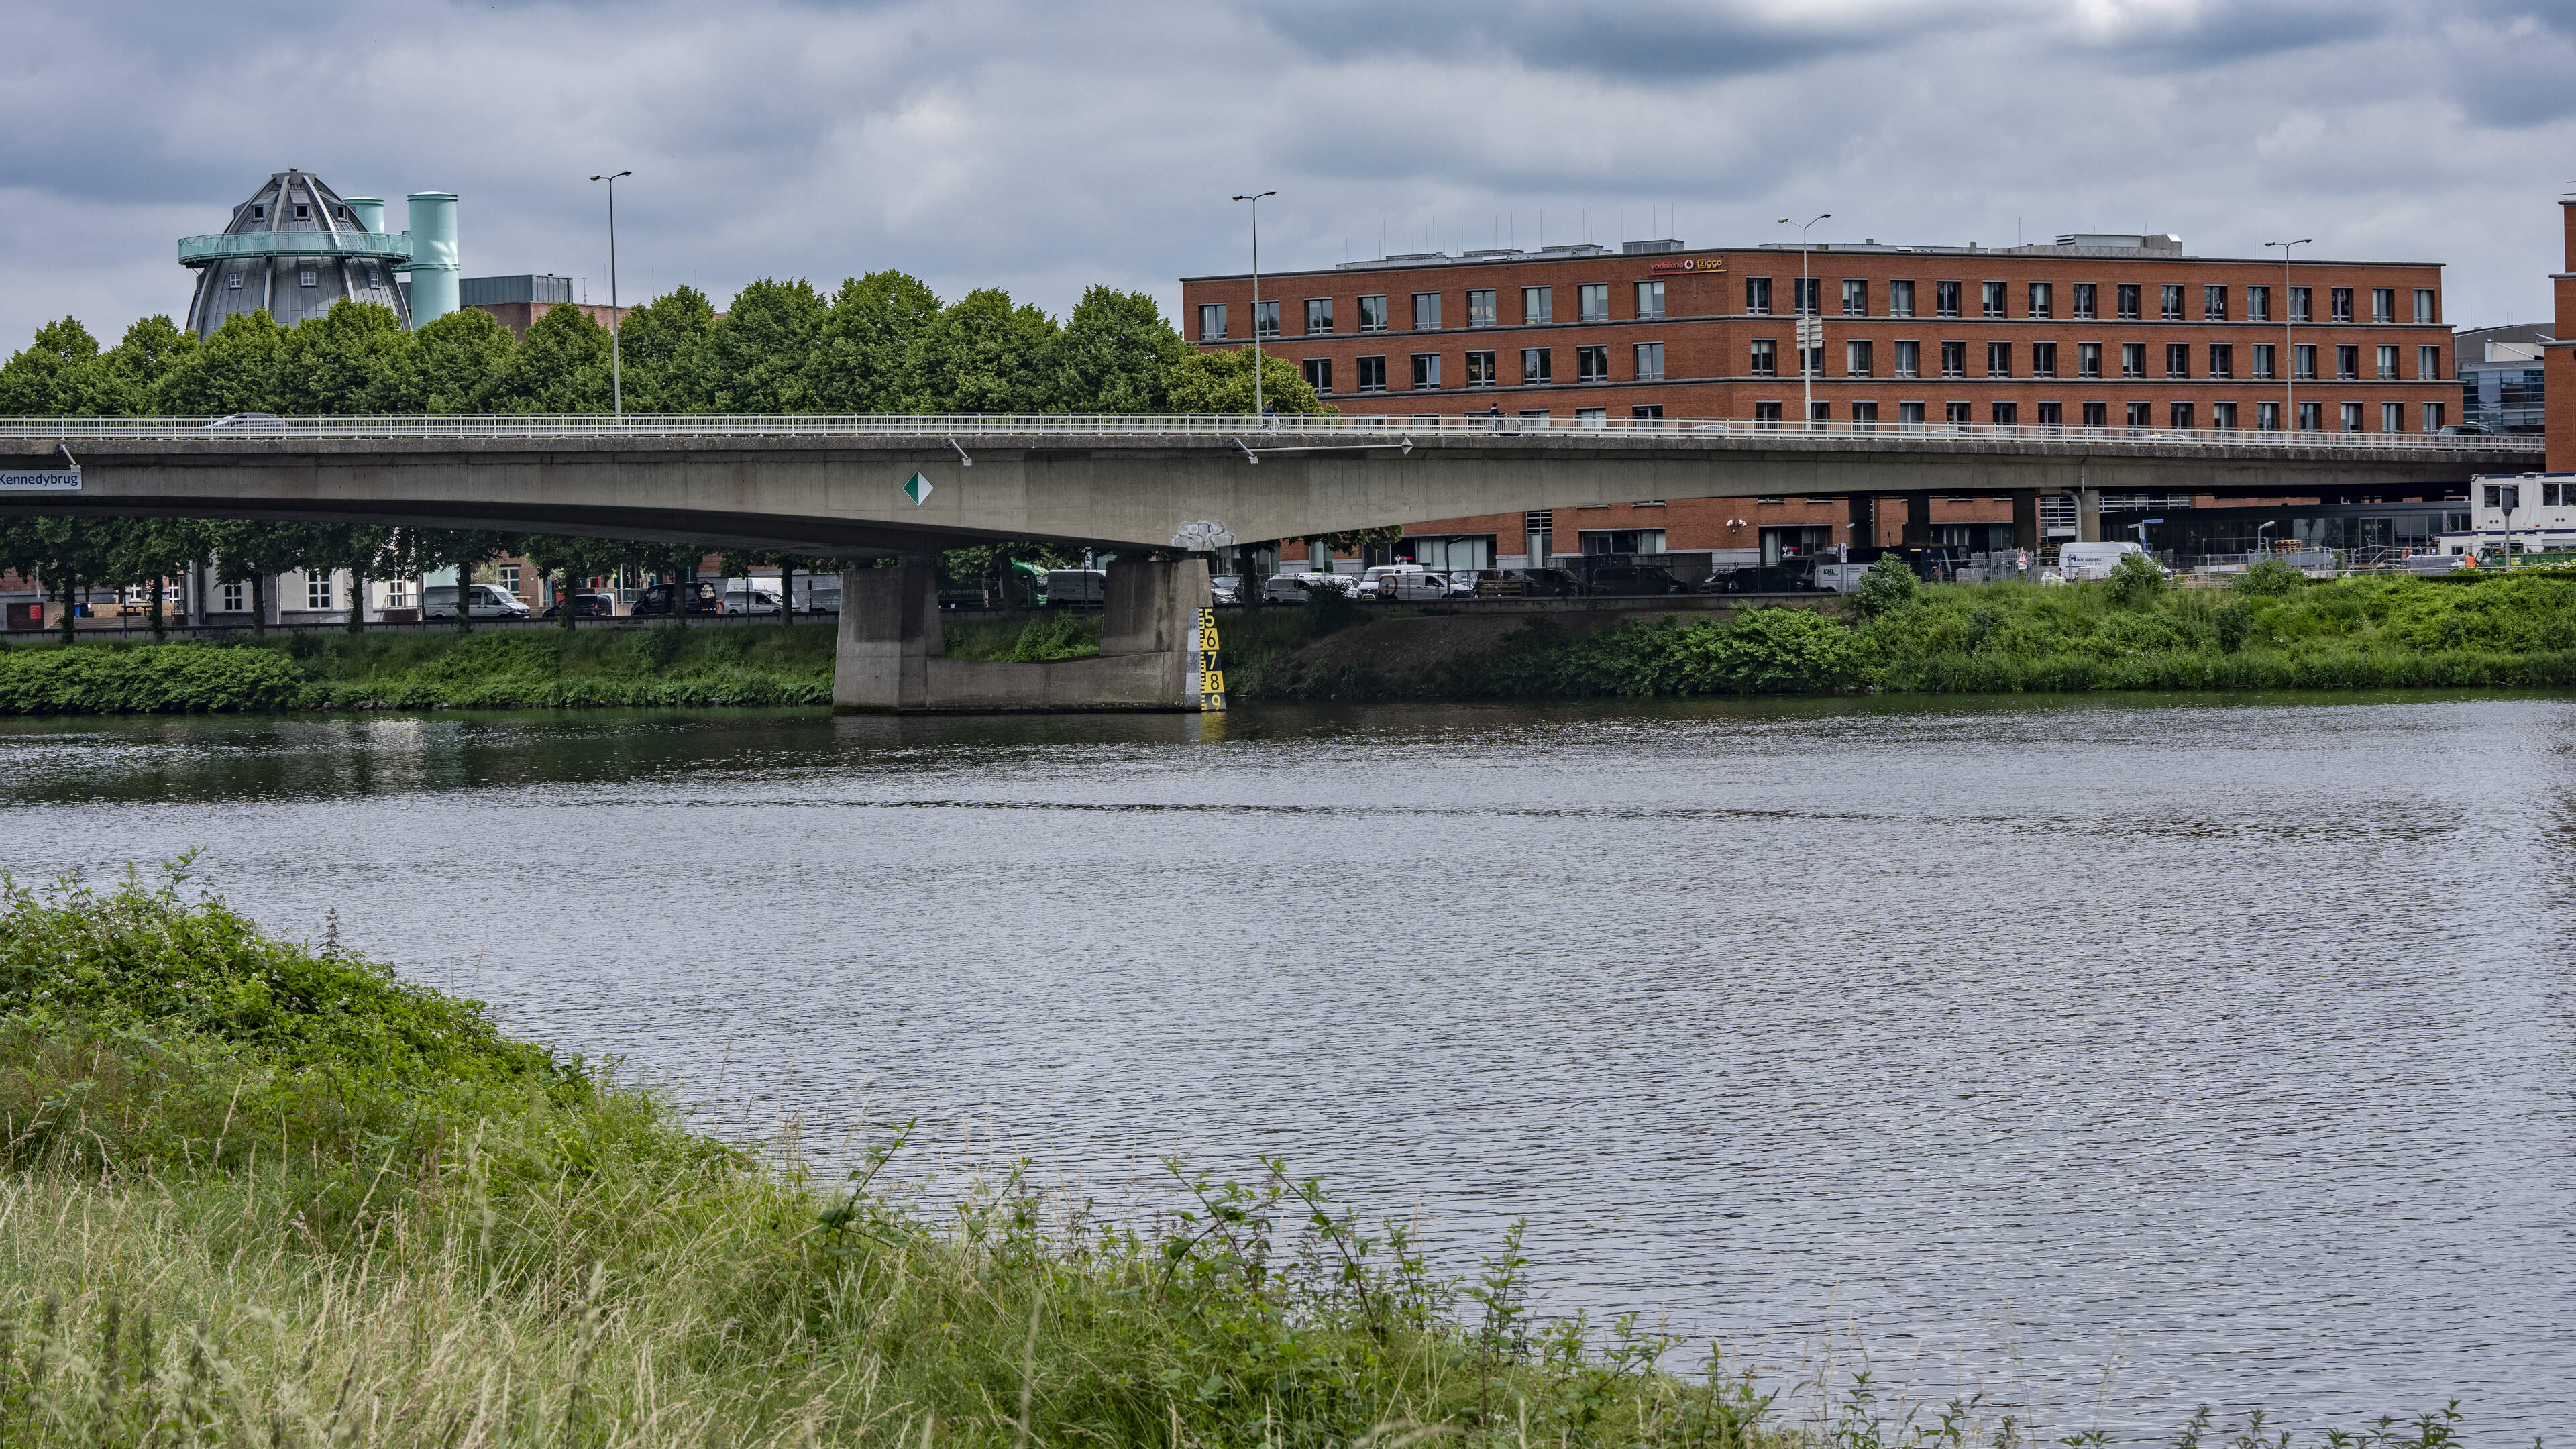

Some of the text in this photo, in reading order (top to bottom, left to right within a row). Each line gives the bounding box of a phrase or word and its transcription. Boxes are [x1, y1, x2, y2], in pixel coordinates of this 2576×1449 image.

[1650, 261, 1684, 270] vodafone
[0, 474, 78, 486] Kennedybrug
[1205, 608, 1215, 627] 5
[1207, 630, 1216, 648] 6
[1208, 651, 1217, 670] 7
[1210, 673, 1219, 690] 8
[1211, 694, 1221, 710] 9
